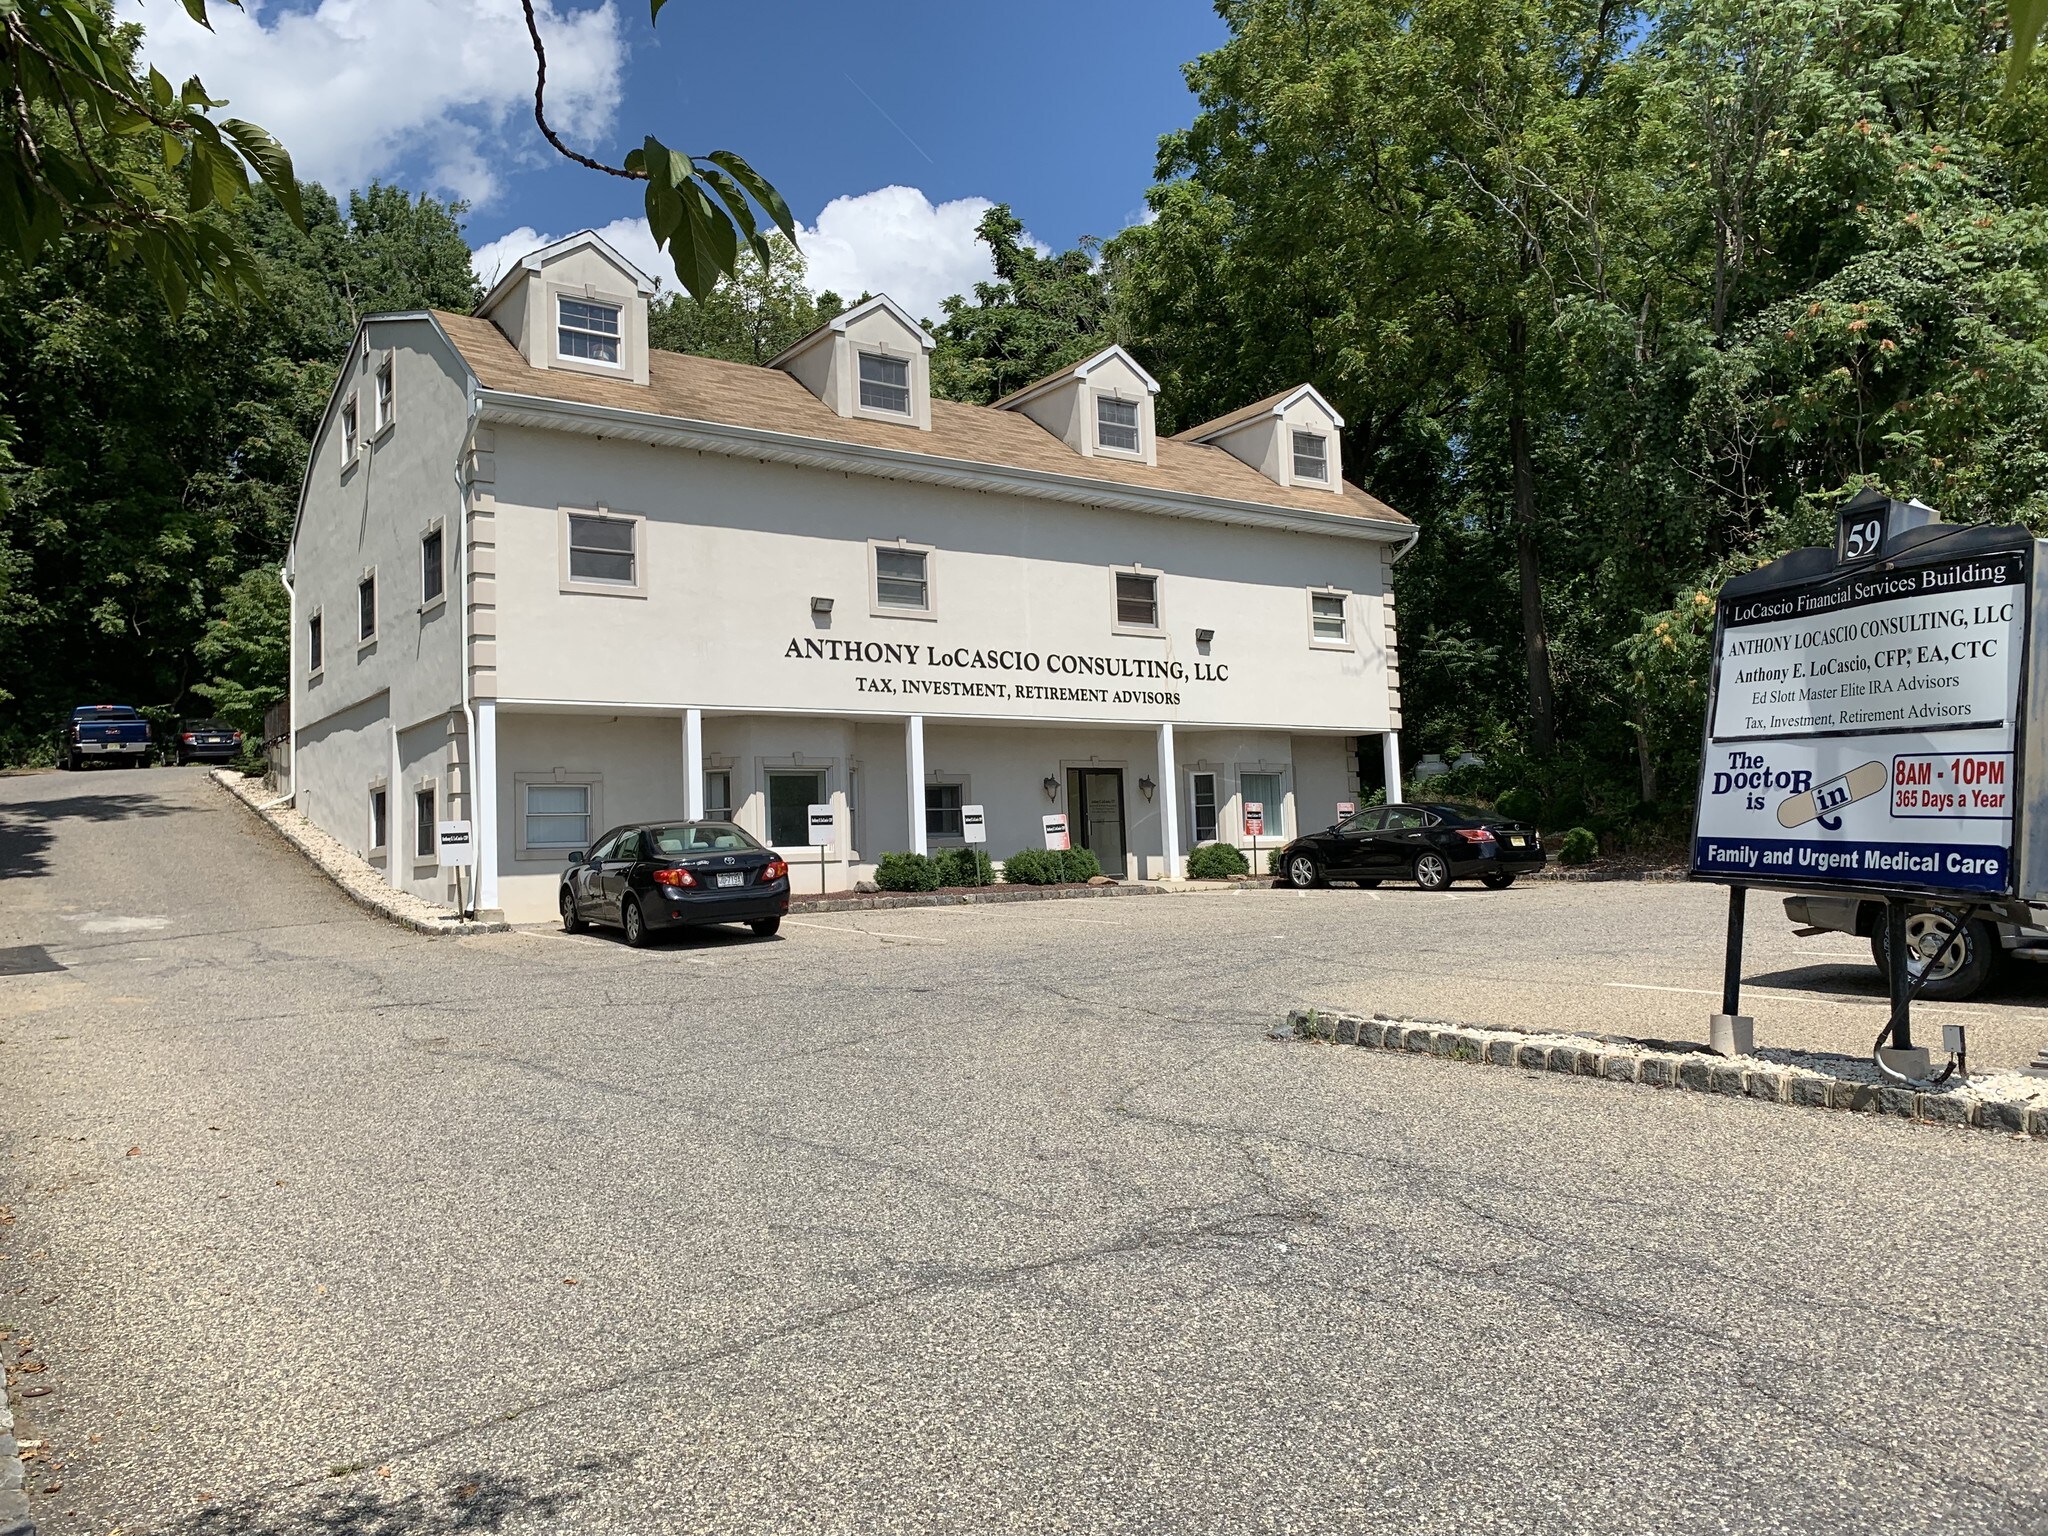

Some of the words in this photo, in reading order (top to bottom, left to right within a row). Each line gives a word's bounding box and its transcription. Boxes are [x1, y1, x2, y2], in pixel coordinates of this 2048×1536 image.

[1847, 520, 1881, 558] 59
[1734, 599, 1793, 621] LoCascio
[1797, 586, 1851, 611] Financial
[1854, 576, 1916, 600] Services
[1922, 564, 2007, 589] Building
[1728, 635, 1793, 657] ANTHONY
[1794, 624, 1857, 649] LOCASCIO
[1860, 608, 1969, 639] CONSULTING,
[1974, 603, 2014, 625] LLC
[784, 637, 921, 665] ANTHONY
[927, 646, 1041, 672] LoCASCIO
[1047, 654, 1189, 683] CONSULTING,
[1194, 662, 1229, 682] LLC
[1735, 666, 1789, 684] Anthony
[1792, 663, 1806, 679] E.
[1810, 654, 1871, 677] LoCascio,
[856, 677, 897, 696] TAX,
[902, 680, 1011, 701] INVESTMENT,
[1015, 684, 1108, 703] RETIREMENT
[1113, 689, 1181, 706] ADVISORS
[1752, 690, 1767, 705] Ed
[1770, 689, 1795, 704] Slott
[1800, 686, 1838, 700] Master
[1840, 683, 1866, 698] Elite
[1869, 680, 1893, 695] IRA
[1896, 674, 1960, 692] Advisors
[1745, 716, 1766, 730] Tax,
[1770, 712, 1835, 729] Investment,
[1839, 707, 1905, 724] Retirement
[1908, 702, 1972, 720] Advisors
[1729, 752, 1764, 770] The
[1896, 760, 1932, 786] 8AM
[1950, 758, 2005, 785] 10PM
[1746, 792, 1765, 811] is
[1817, 786, 1849, 811] in
[1896, 790, 1918, 808] 365
[1922, 789, 1954, 812] Days
[1957, 794, 1967, 808] a
[1971, 789, 2005, 808] Year
[1708, 845, 1759, 868] Family
[1763, 847, 1793, 866] and
[1799, 847, 1859, 871] Urgent
[1864, 850, 1939, 873] Medical
[1946, 853, 1999, 875] Care
